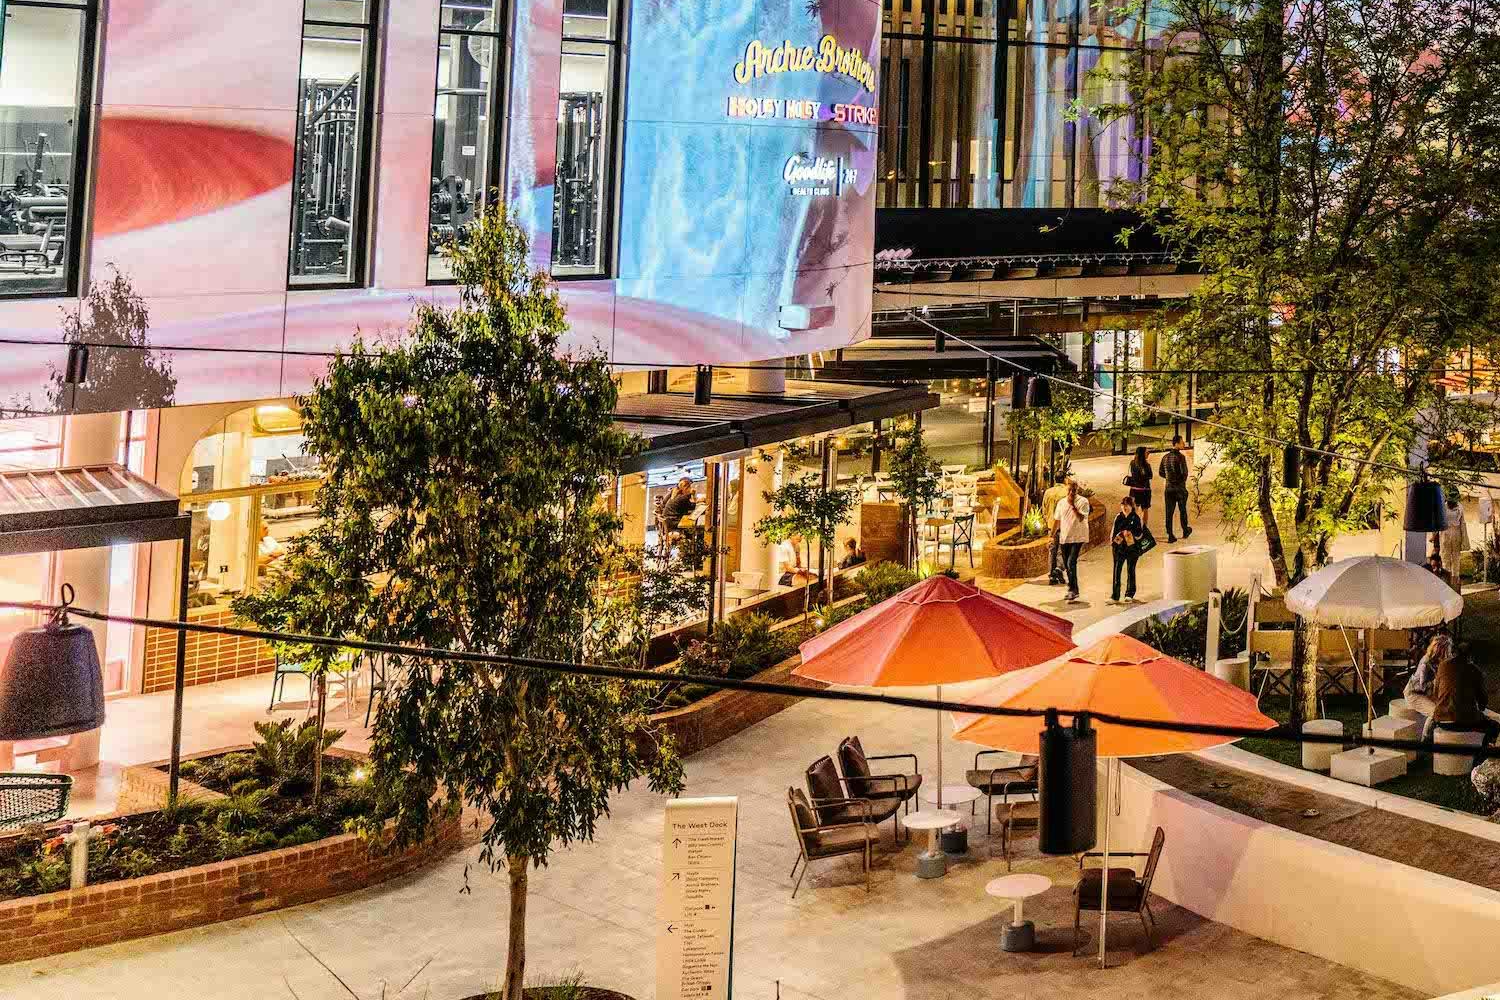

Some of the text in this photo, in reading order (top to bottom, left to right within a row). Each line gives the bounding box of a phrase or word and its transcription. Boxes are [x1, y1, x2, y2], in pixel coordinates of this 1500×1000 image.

[734, 33, 876, 93] Archie Brothers
[728, 96, 822, 120] HOLEY MOLEY
[783, 155, 836, 185] Goodlife
